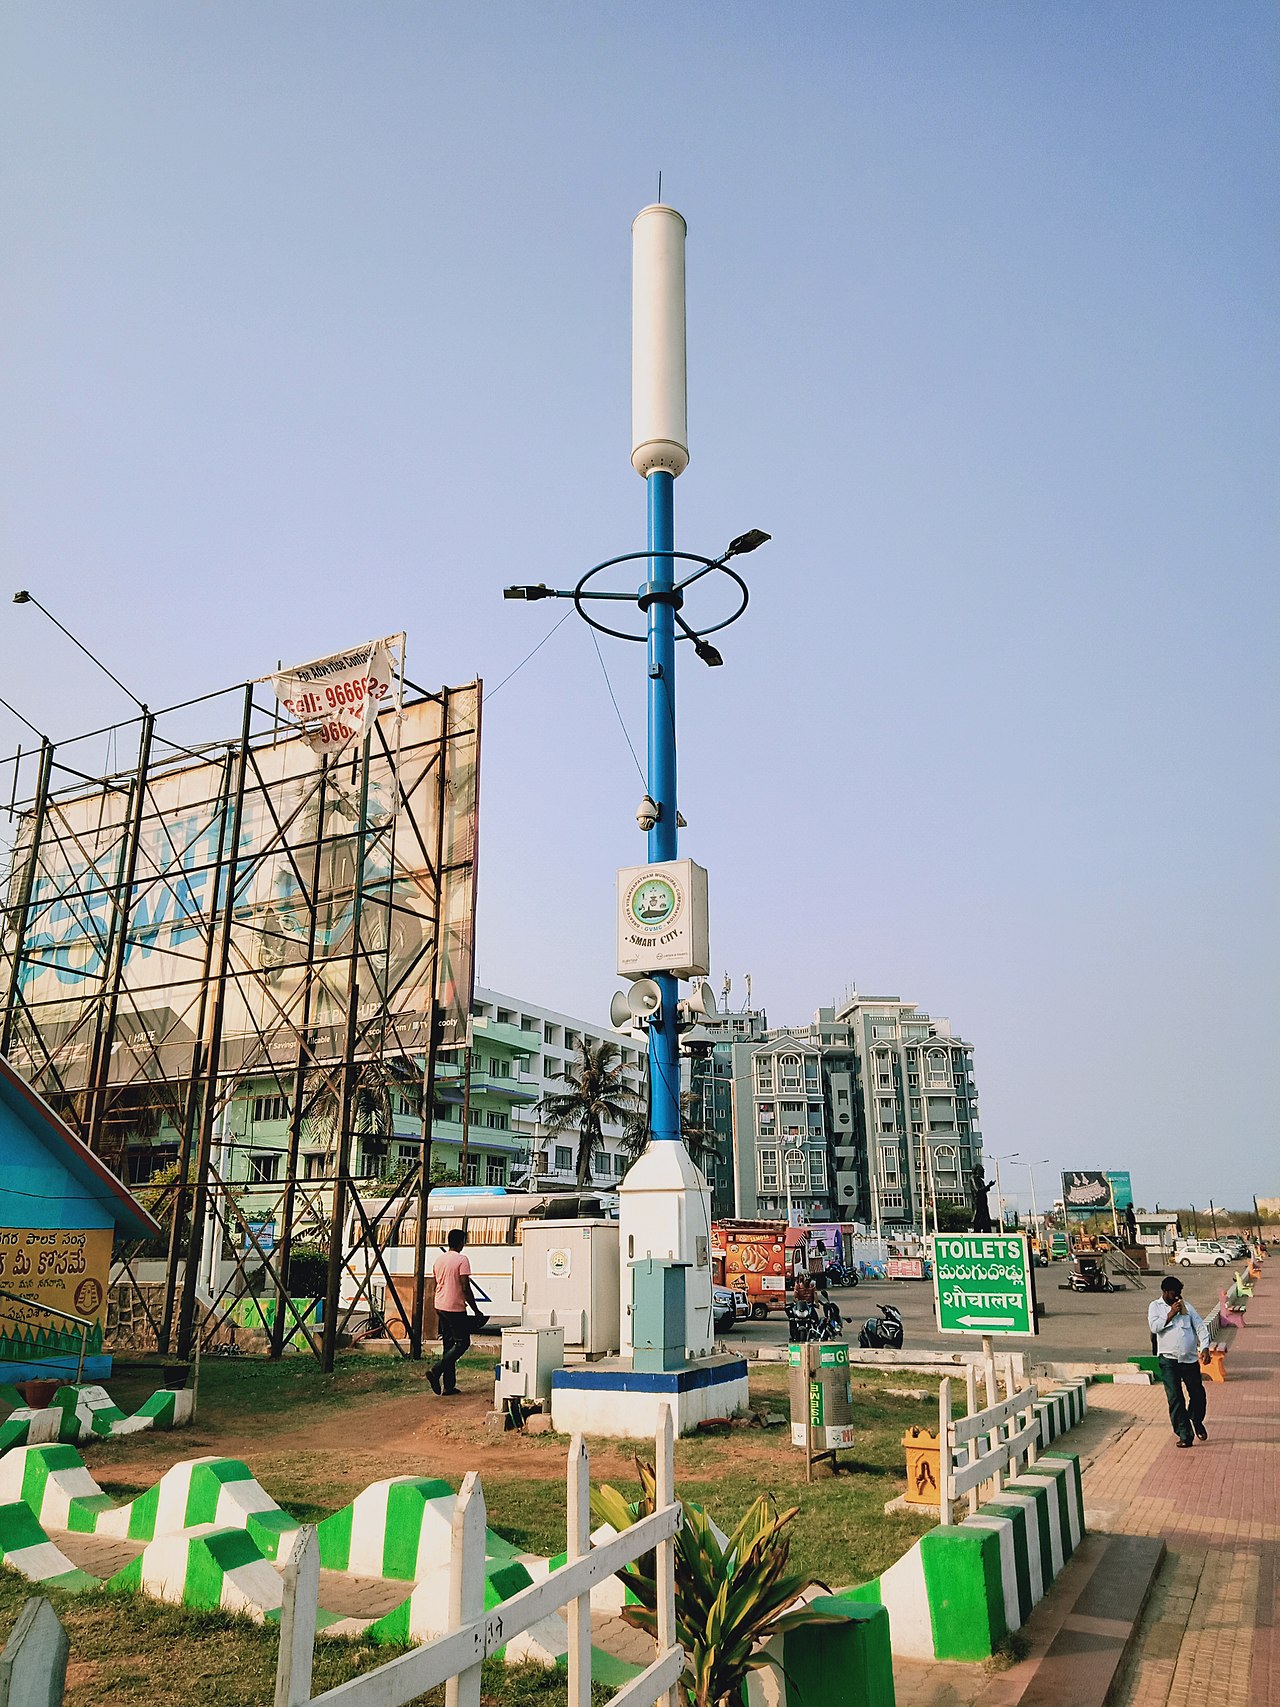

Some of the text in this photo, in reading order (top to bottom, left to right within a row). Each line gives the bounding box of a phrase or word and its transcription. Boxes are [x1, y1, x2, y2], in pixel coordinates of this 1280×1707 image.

[296, 670, 312, 682] For
[310, 657, 346, 679] Advertise
[628, 928, 679, 947] SMART CITY
[26, 1232, 57, 1245] పాలక
[938, 1241, 1020, 1258] TOILETS
[13, 1248, 31, 1275] మీ
[37, 1248, 86, 1275] కోసమే
[943, 1285, 1023, 1309] शौचालय
